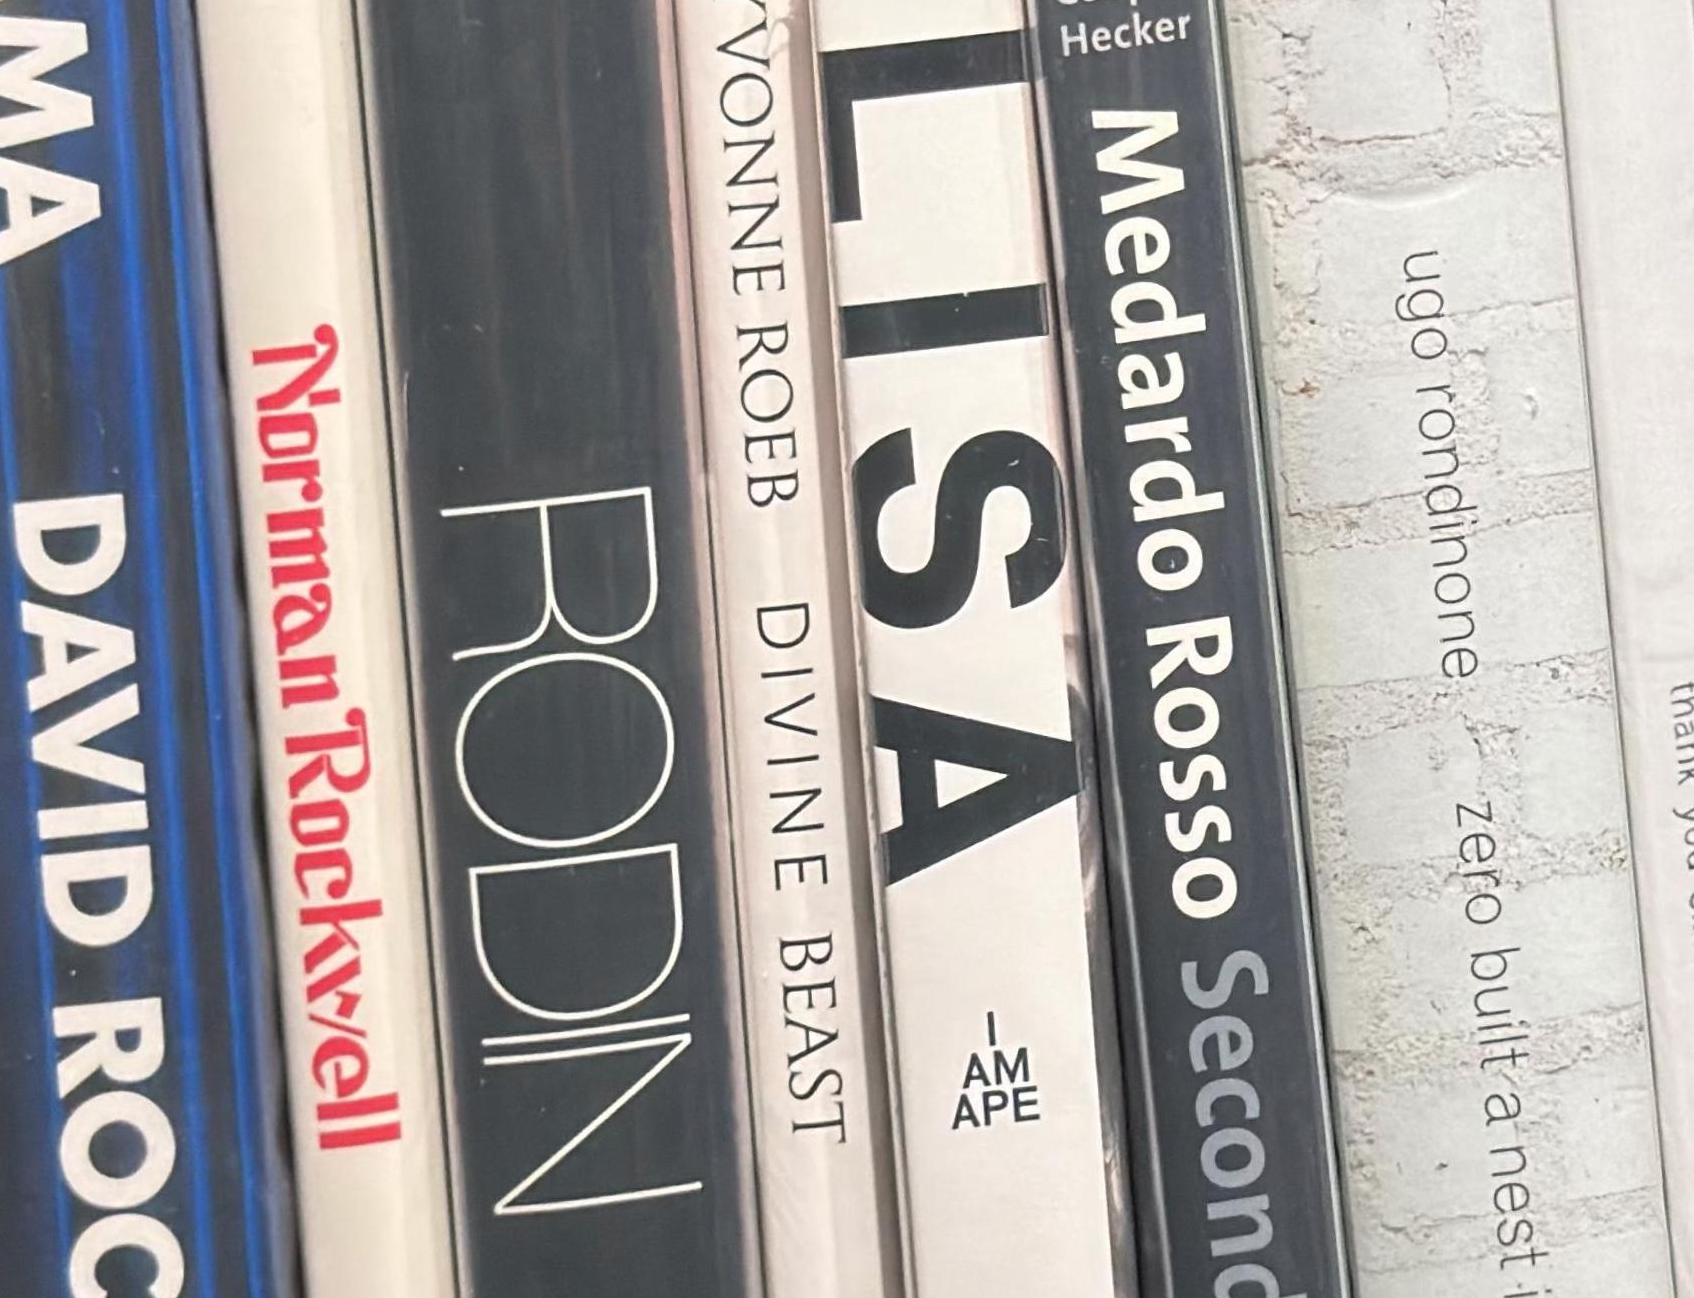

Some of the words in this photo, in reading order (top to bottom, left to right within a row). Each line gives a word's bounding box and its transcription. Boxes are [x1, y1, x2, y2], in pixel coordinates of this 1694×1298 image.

[1059, 8, 1192, 57] Hecker
[1091, 109, 1225, 592] Medardo
[1395, 250, 1449, 360] ugo
[737, 322, 800, 510] ROEB
[820, 28, 1084, 887] LISA
[251, 324, 342, 709] Norman
[1415, 383, 1480, 680] rondinone
[13, 492, 154, 947] DAVID
[756, 602, 829, 891] DIVINE
[1145, 616, 1238, 919] Rosso
[283, 708, 402, 1151] Rockwell
[441, 486, 703, 1215] RODIN
[1456, 801, 1503, 924] zero
[778, 932, 847, 1144] BEAST
[962, 1047, 1031, 1088] AM
[985, 1010, 997, 1046] I
[1470, 947, 1530, 1070] built
[951, 1088, 1042, 1130] APE
[1484, 1093, 1523, 1126] a
[1490, 1145, 1549, 1269] nest
